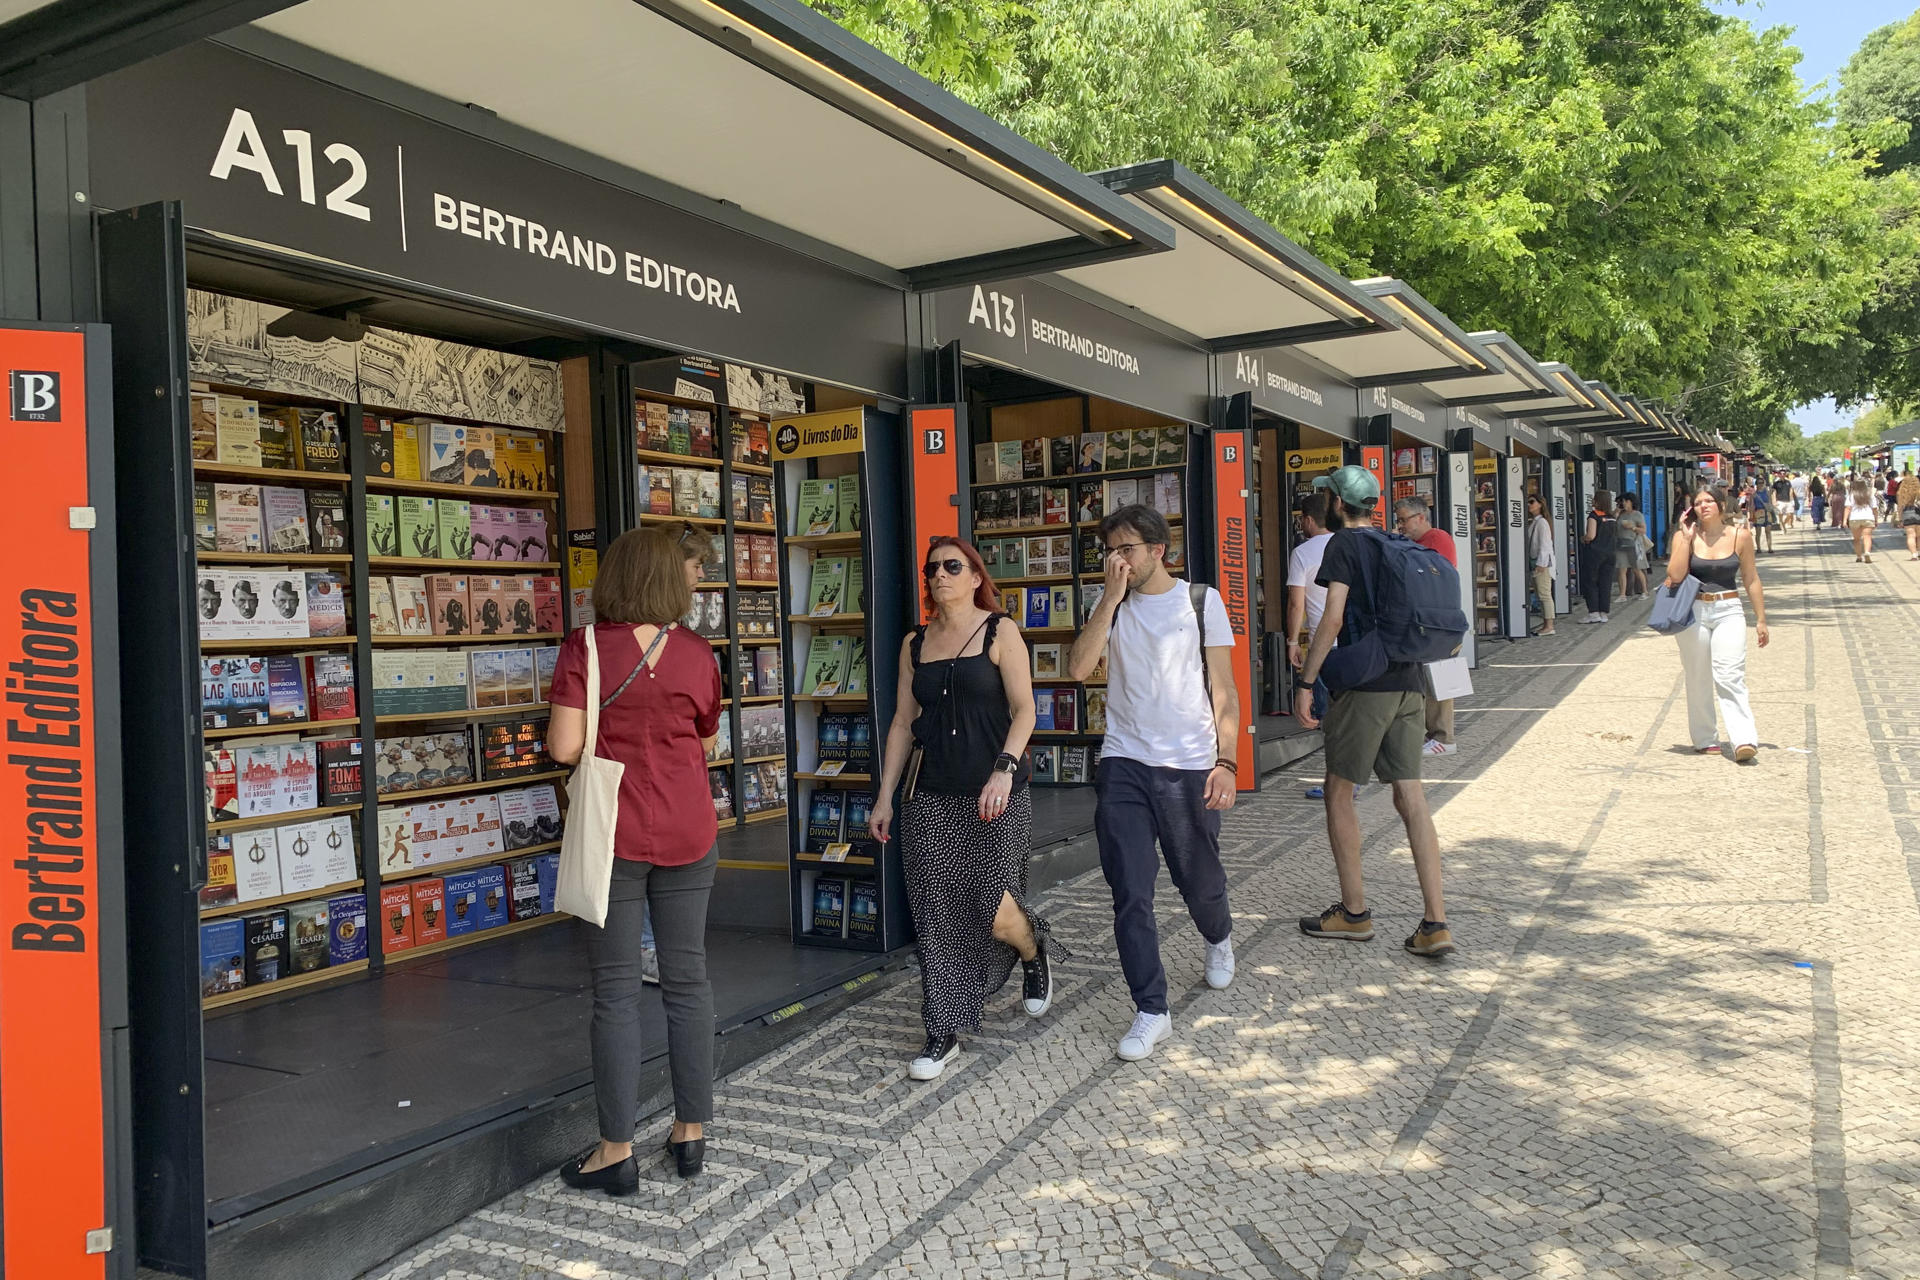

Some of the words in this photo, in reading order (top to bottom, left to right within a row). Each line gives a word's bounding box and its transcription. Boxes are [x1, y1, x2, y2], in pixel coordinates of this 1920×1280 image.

[209, 107, 371, 223] A12
[434, 192, 616, 276] BERTRAND
[625, 252, 741, 314] EDITORA
[968, 284, 1016, 338] A13
[1031, 318, 1094, 358] BERTRAND
[1096, 343, 1140, 376] EDITORA
[1236, 351, 1259, 388] A14
[19, 374, 55, 411] B
[1267, 372, 1300, 398] BERTRAND
[1300, 386, 1323, 408] EDITORA
[1373, 387, 1387, 409] A15
[1391, 397, 1410, 416] BERTRAND
[1410, 406, 1425, 423] EDITORA
[803, 428, 830, 445] Livros
[831, 425, 842, 442] do
[843, 423, 858, 441] Dia
[927, 430, 944, 450] B
[306, 446, 339, 458] FREUD
[1225, 446, 1236, 460] B
[1305, 456, 1320, 465] Livros
[1321, 456, 1329, 464] do
[1330, 454, 1339, 463] Dia
[1369, 458, 1378, 469] B
[1510, 499, 1522, 528] Quetzal
[1555, 496, 1565, 520] Quetzal
[1454, 504, 1469, 538] Quetzal
[573, 531, 595, 542] Sabia?
[1223, 517, 1242, 568] Editora
[6, 588, 81, 747] Editora
[203, 684, 224, 700] LAG
[232, 682, 265, 698] GULAG
[824, 716, 848, 724] MICHIO
[854, 716, 869, 724] MICH
[820, 750, 847, 758] DIVINA
[850, 749, 870, 758] DIVIN
[328, 767, 362, 784] FOME
[329, 783, 362, 793] VERMELHA
[814, 794, 839, 803] MICHIO
[850, 796, 872, 804] MICHIO
[809, 828, 837, 837] DIVINA
[848, 829, 873, 840] DIVINA
[10, 755, 85, 953] Bertrand
[448, 879, 476, 892] MÍTICAS
[477, 874, 503, 885] MÍTICAS
[415, 887, 442, 899] MÍTICAS
[818, 884, 840, 892] MICHIO
[854, 887, 877, 896] MICHIO
[382, 893, 409, 906] MÍTICAS
[814, 917, 840, 928] DIVINA
[850, 920, 875, 933] DIVINA
[250, 932, 284, 945] CÉSARES
[294, 933, 327, 946] CÉSARES
